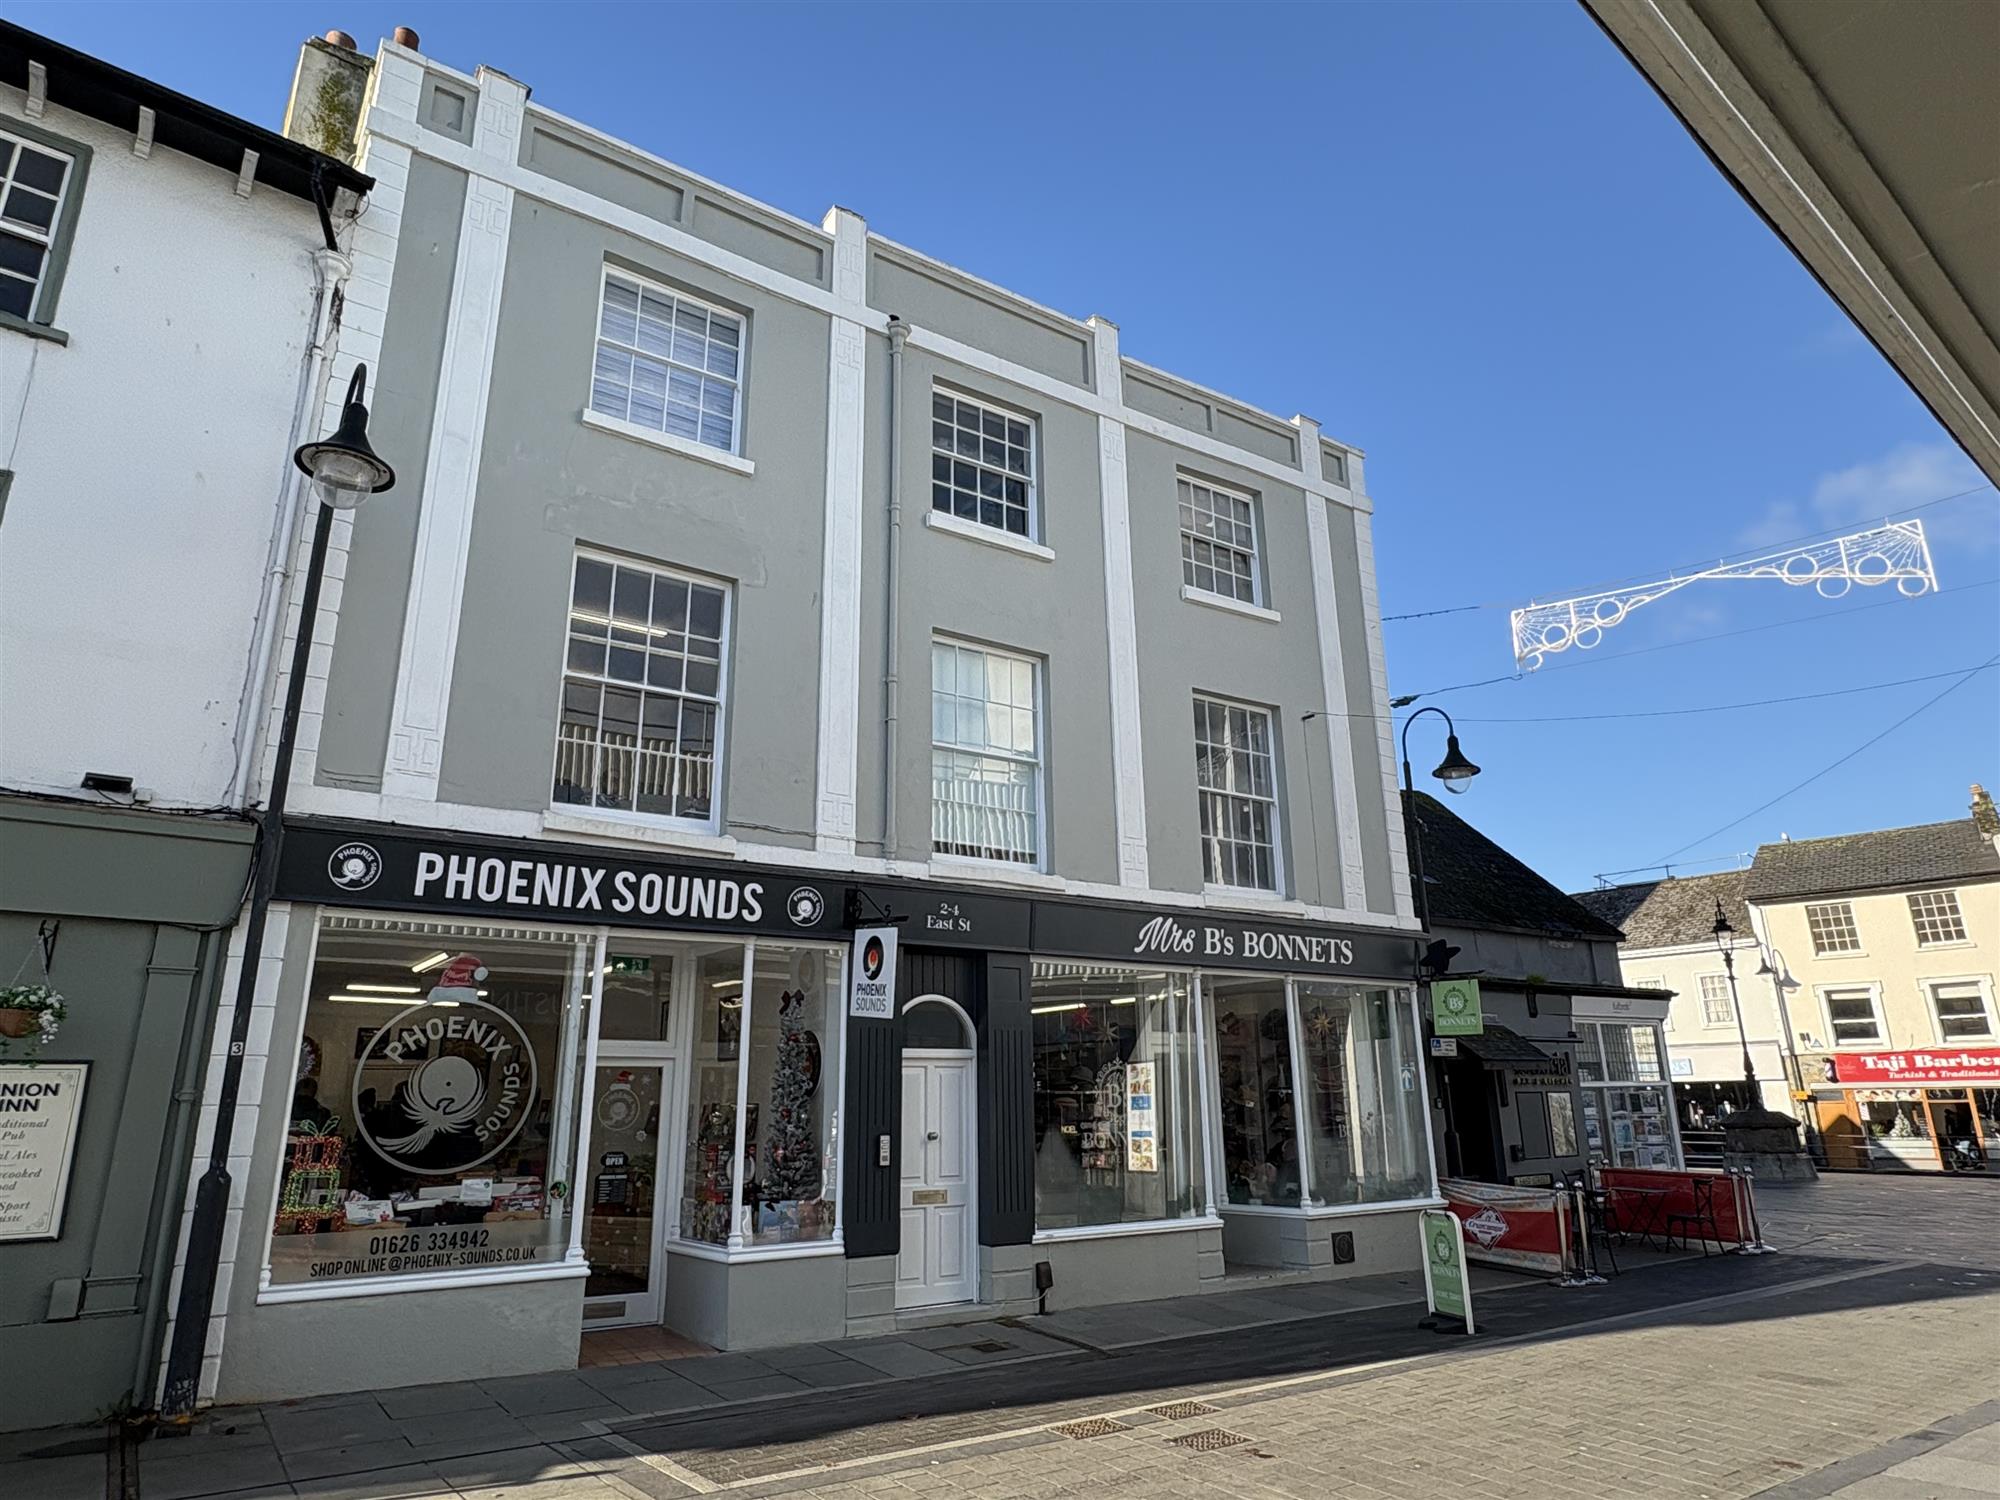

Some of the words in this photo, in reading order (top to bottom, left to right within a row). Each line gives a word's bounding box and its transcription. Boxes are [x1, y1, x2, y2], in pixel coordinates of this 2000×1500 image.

[338, 847, 375, 862] PHOENIX
[413, 852, 607, 911] PHOENIX
[611, 870, 764, 922] SOUNDS
[793, 890, 819, 903] PHOENIX
[939, 902, 960, 916] 2-4
[926, 915, 954, 930] East
[958, 917, 971, 932] St
[1134, 916, 1197, 953] Mrs
[1203, 927, 1234, 956] B's
[1242, 931, 1353, 966] BONNETS
[856, 983, 887, 997] PHOENIX
[855, 997, 887, 1012] SOUNDS
[1449, 997, 1463, 1010] B's
[1438, 1016, 1477, 1026] BONNETS
[384, 1016, 512, 1064] PHOENIX
[232, 1043, 242, 1054] 3
[1861, 1056, 1908, 1071] Taji
[1888, 1070, 1926, 1079] Turkish
[1927, 1070, 1937, 1078] &
[1940, 1069, 1998, 1078] Traditional
[0, 1083, 61, 1097] NION
[474, 1063, 520, 1142] SOUNDS
[0, 1118, 49, 1129] ditional
[1, 1130, 26, 1140] Pub
[11, 1149, 38, 1160] Ales
[605, 1157, 624, 1166] OPEN
[0, 1168, 42, 1179] cooked
[369, 1234, 421, 1255] 01626
[427, 1229, 490, 1251] 334942
[310, 1246, 537, 1278] SHOPONLINE@PHOENIX-SOUNDS.CO.UK
